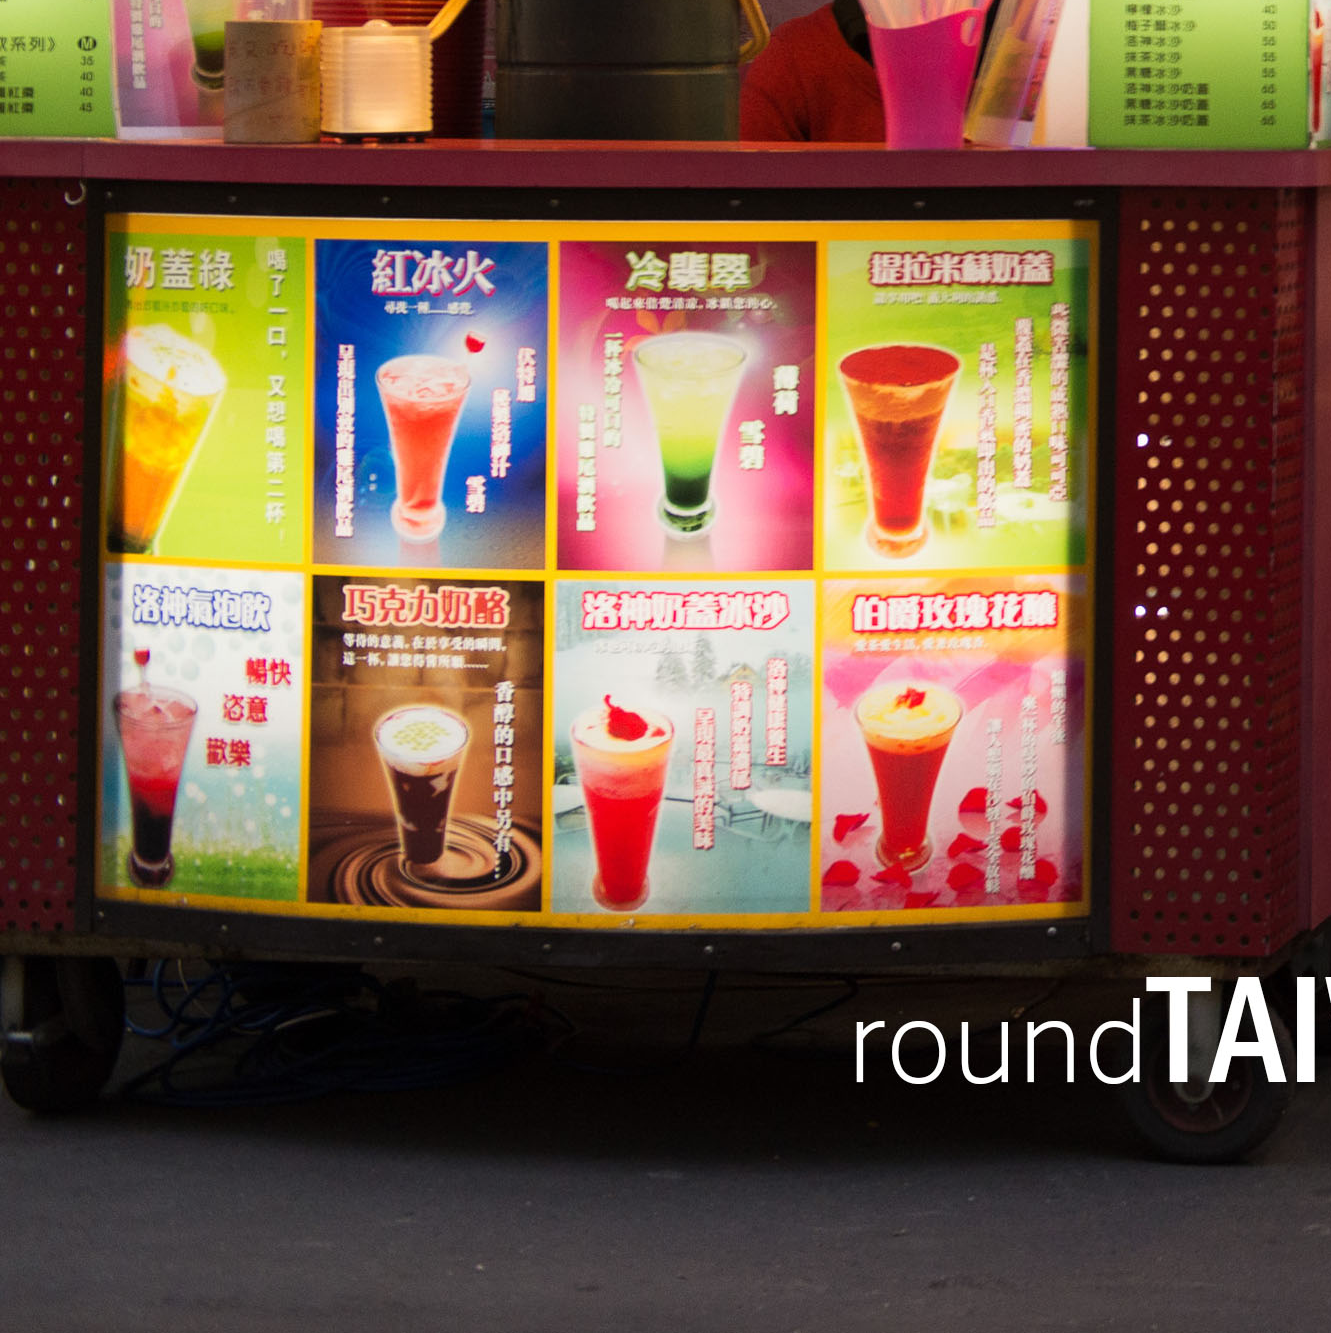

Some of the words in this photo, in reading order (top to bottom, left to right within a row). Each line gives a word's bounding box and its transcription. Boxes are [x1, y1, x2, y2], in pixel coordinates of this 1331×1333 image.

[122, 245, 236, 291] 奶蓋綠
[371, 249, 497, 297] 紅冰火
[625, 250, 752, 292] 冷翡翠
[869, 251, 1054, 287] 提拉米蘇奶蓋
[132, 584, 272, 632] 洛神氣泡飲
[342, 585, 511, 629] 巧克力奶酪
[582, 591, 790, 631] 洛神奶蓋冰沙
[852, 592, 1058, 633] 伯爵玫瑰花釀
[246, 657, 293, 687] 暢快
[223, 693, 269, 724] 恣意
[206, 737, 252, 768] 歡樂
